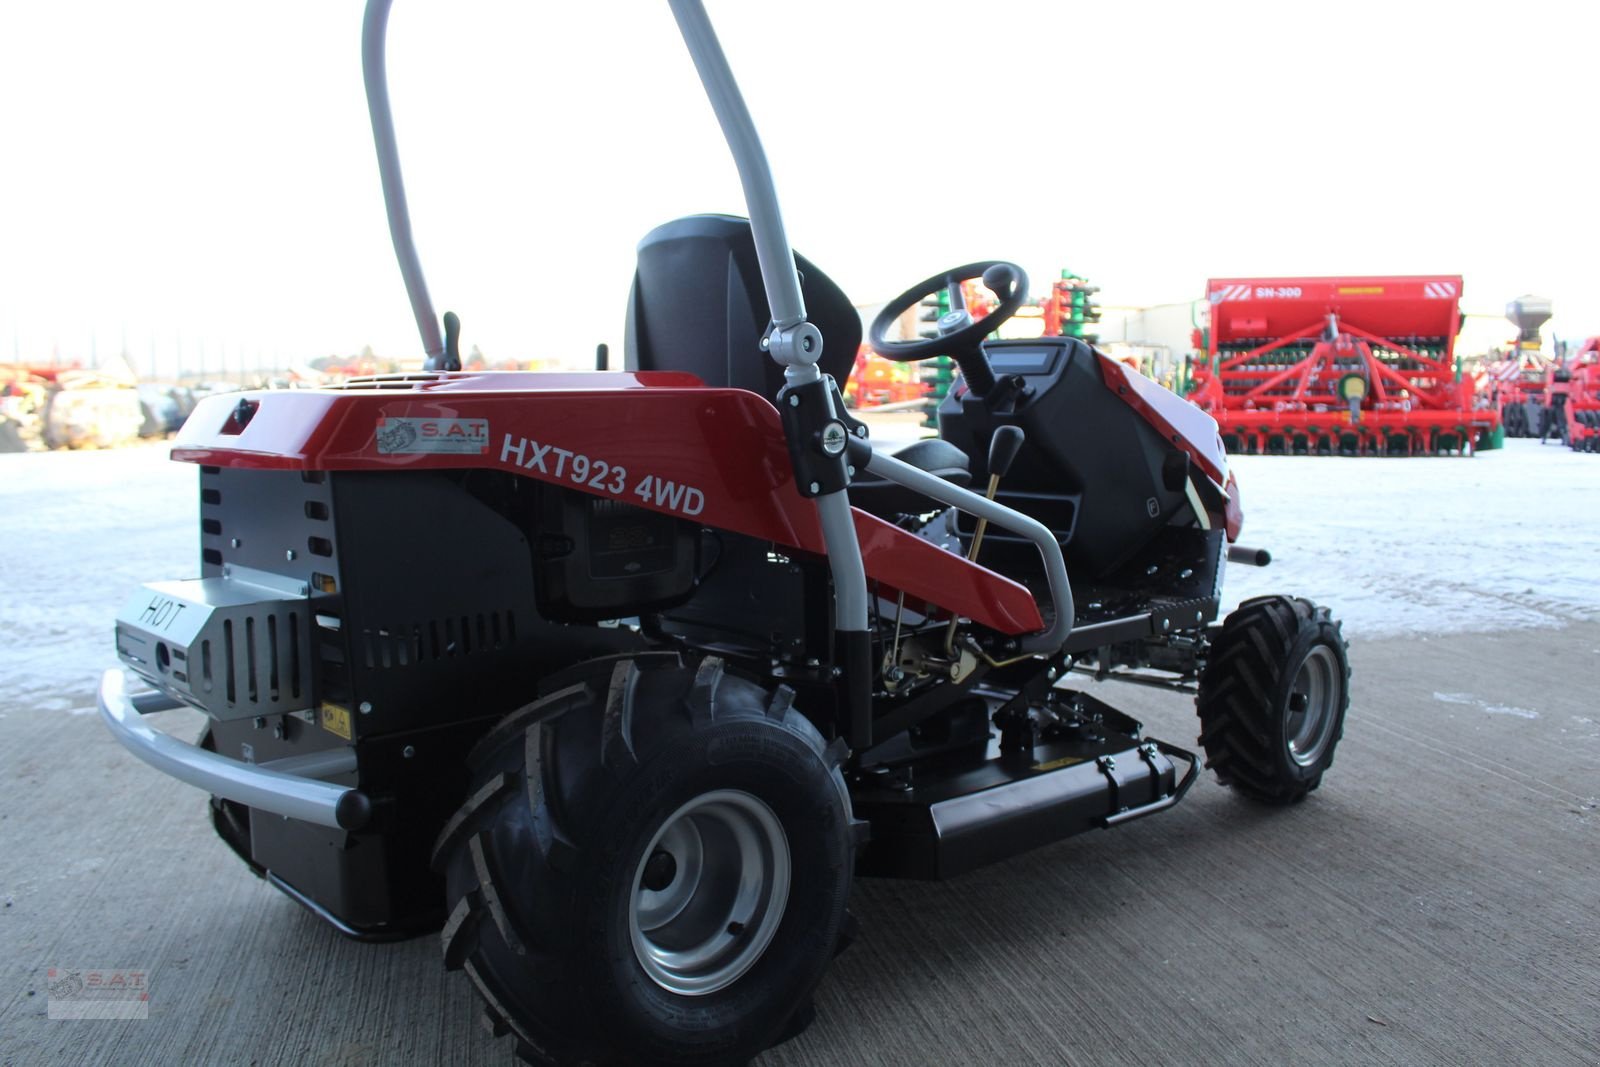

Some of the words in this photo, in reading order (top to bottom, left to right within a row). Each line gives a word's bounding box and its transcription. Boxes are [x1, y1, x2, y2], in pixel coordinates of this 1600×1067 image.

[1256, 287, 1302, 298] SN-300
[501, 433, 626, 494] HXT923
[635, 475, 705, 515] 4WD
[139, 596, 186, 631] HOT
